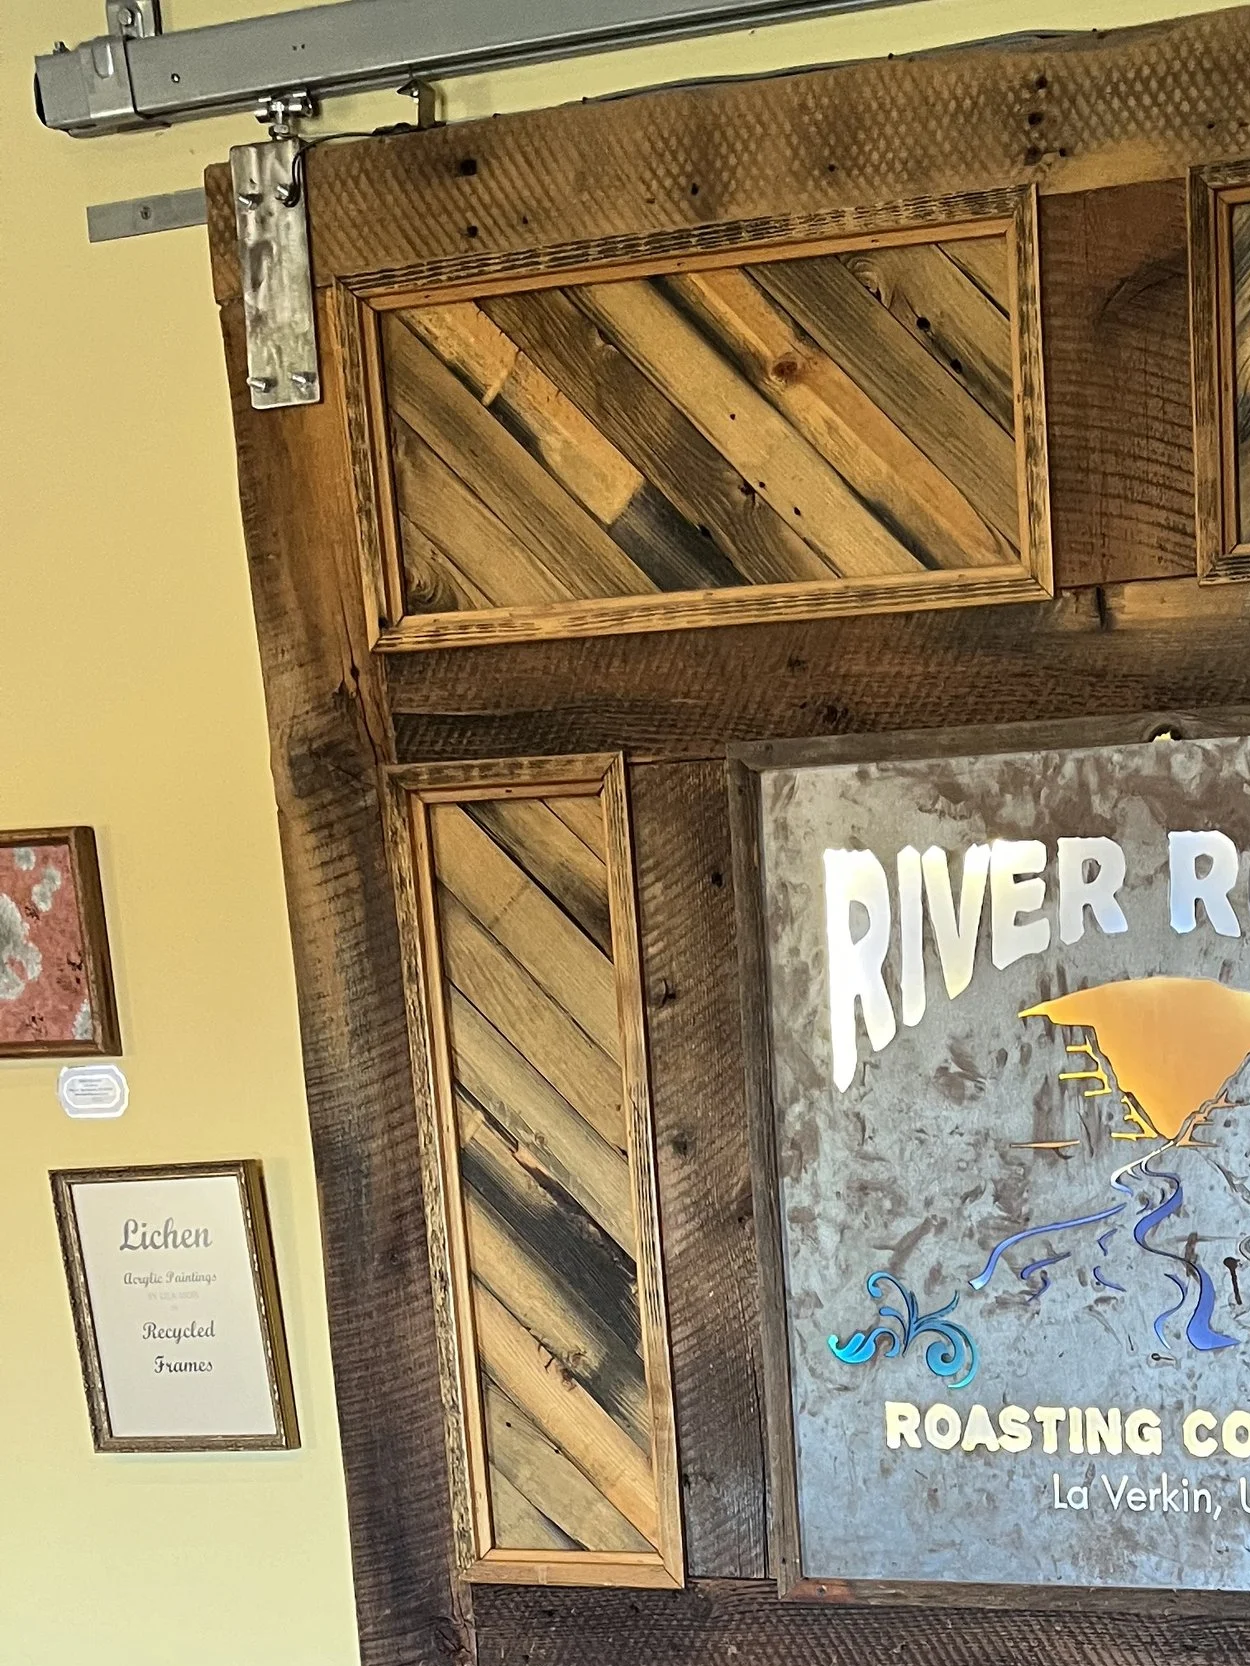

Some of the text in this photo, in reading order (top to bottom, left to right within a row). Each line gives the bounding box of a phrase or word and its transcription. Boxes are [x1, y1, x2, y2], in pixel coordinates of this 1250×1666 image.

[823, 836, 1129, 1093] RIVER
[119, 1216, 213, 1251] Lichen
[123, 1270, 217, 1288] Acrylic Paintings
[142, 1319, 216, 1345] Recycled
[154, 1355, 213, 1374] Frames
[884, 1400, 1163, 1456] ROASTING
[1052, 1472, 1090, 1511] La
[1100, 1471, 1223, 1521] Verkin,
